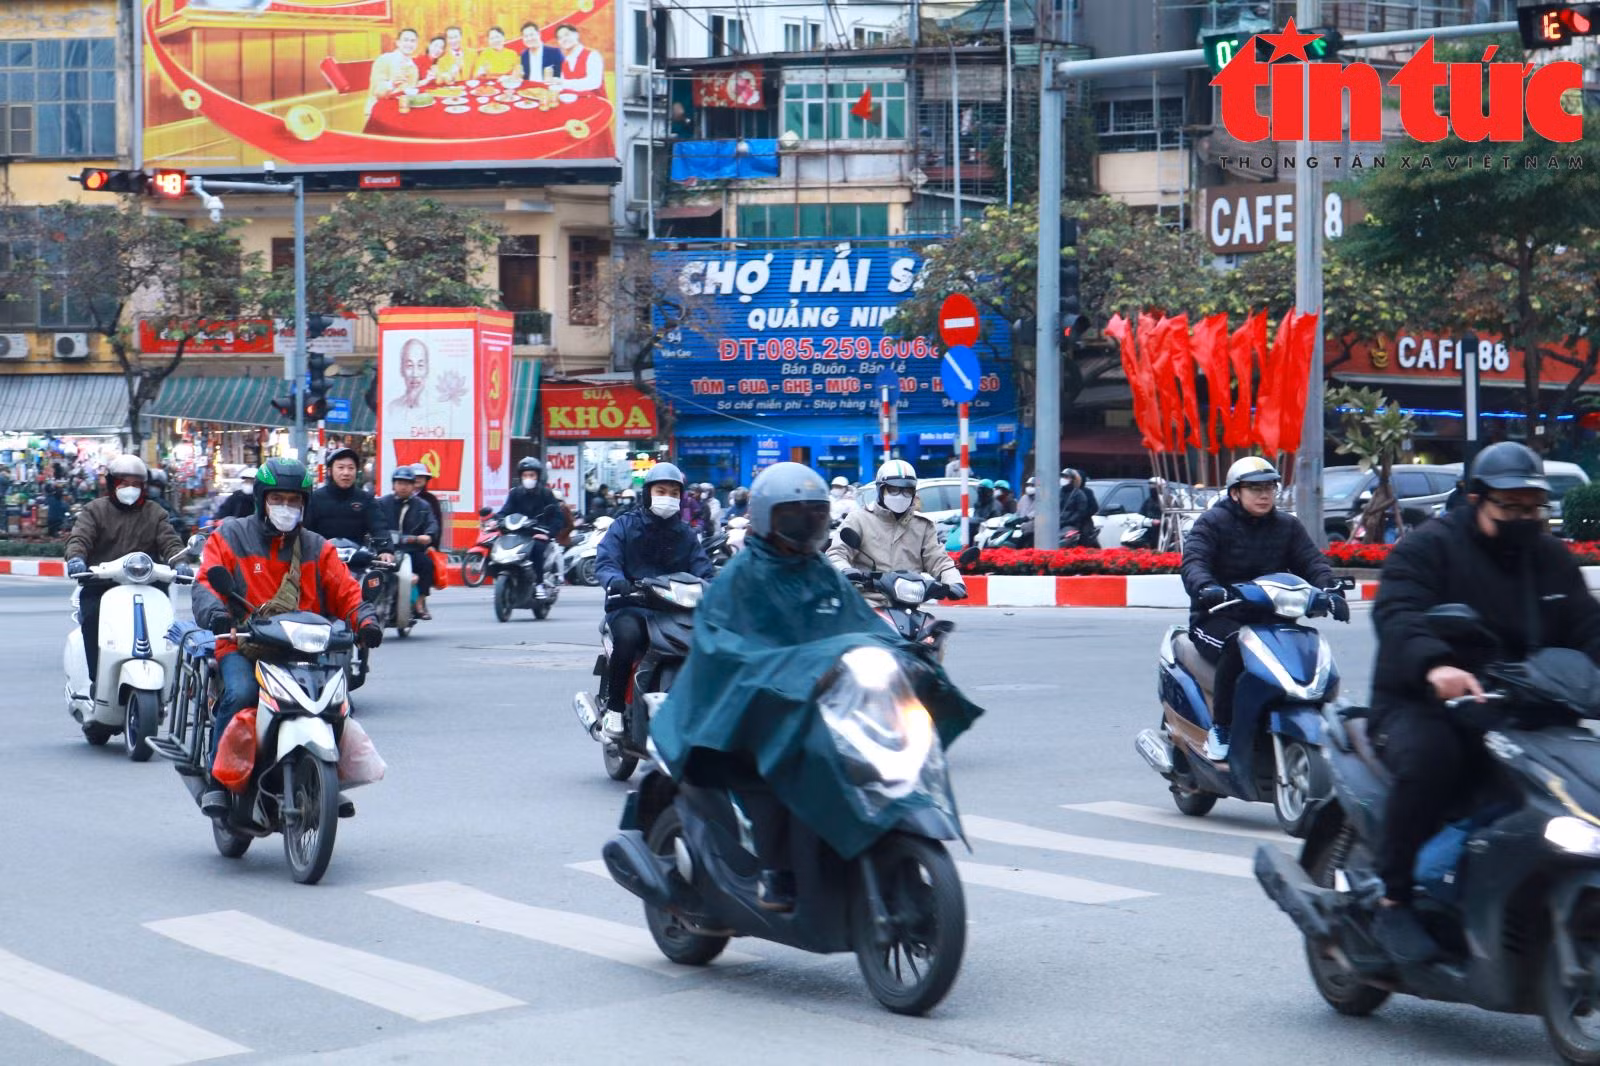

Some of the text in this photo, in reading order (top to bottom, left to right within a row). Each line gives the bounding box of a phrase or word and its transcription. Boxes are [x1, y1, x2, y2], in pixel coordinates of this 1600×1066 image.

[1210, 193, 1294, 247] CAFE
[677, 252, 775, 304] CHỢ
[746, 298, 898, 332] QUẢNG NIN
[781, 362, 808, 375] Bán
[812, 362, 847, 375] Buôn
[1477, 340, 1510, 371] 88
[690, 376, 725, 395] TÔM
[738, 378, 769, 394] CUA
[547, 399, 652, 429] KHÓA
[812, 399, 838, 411] Ship
